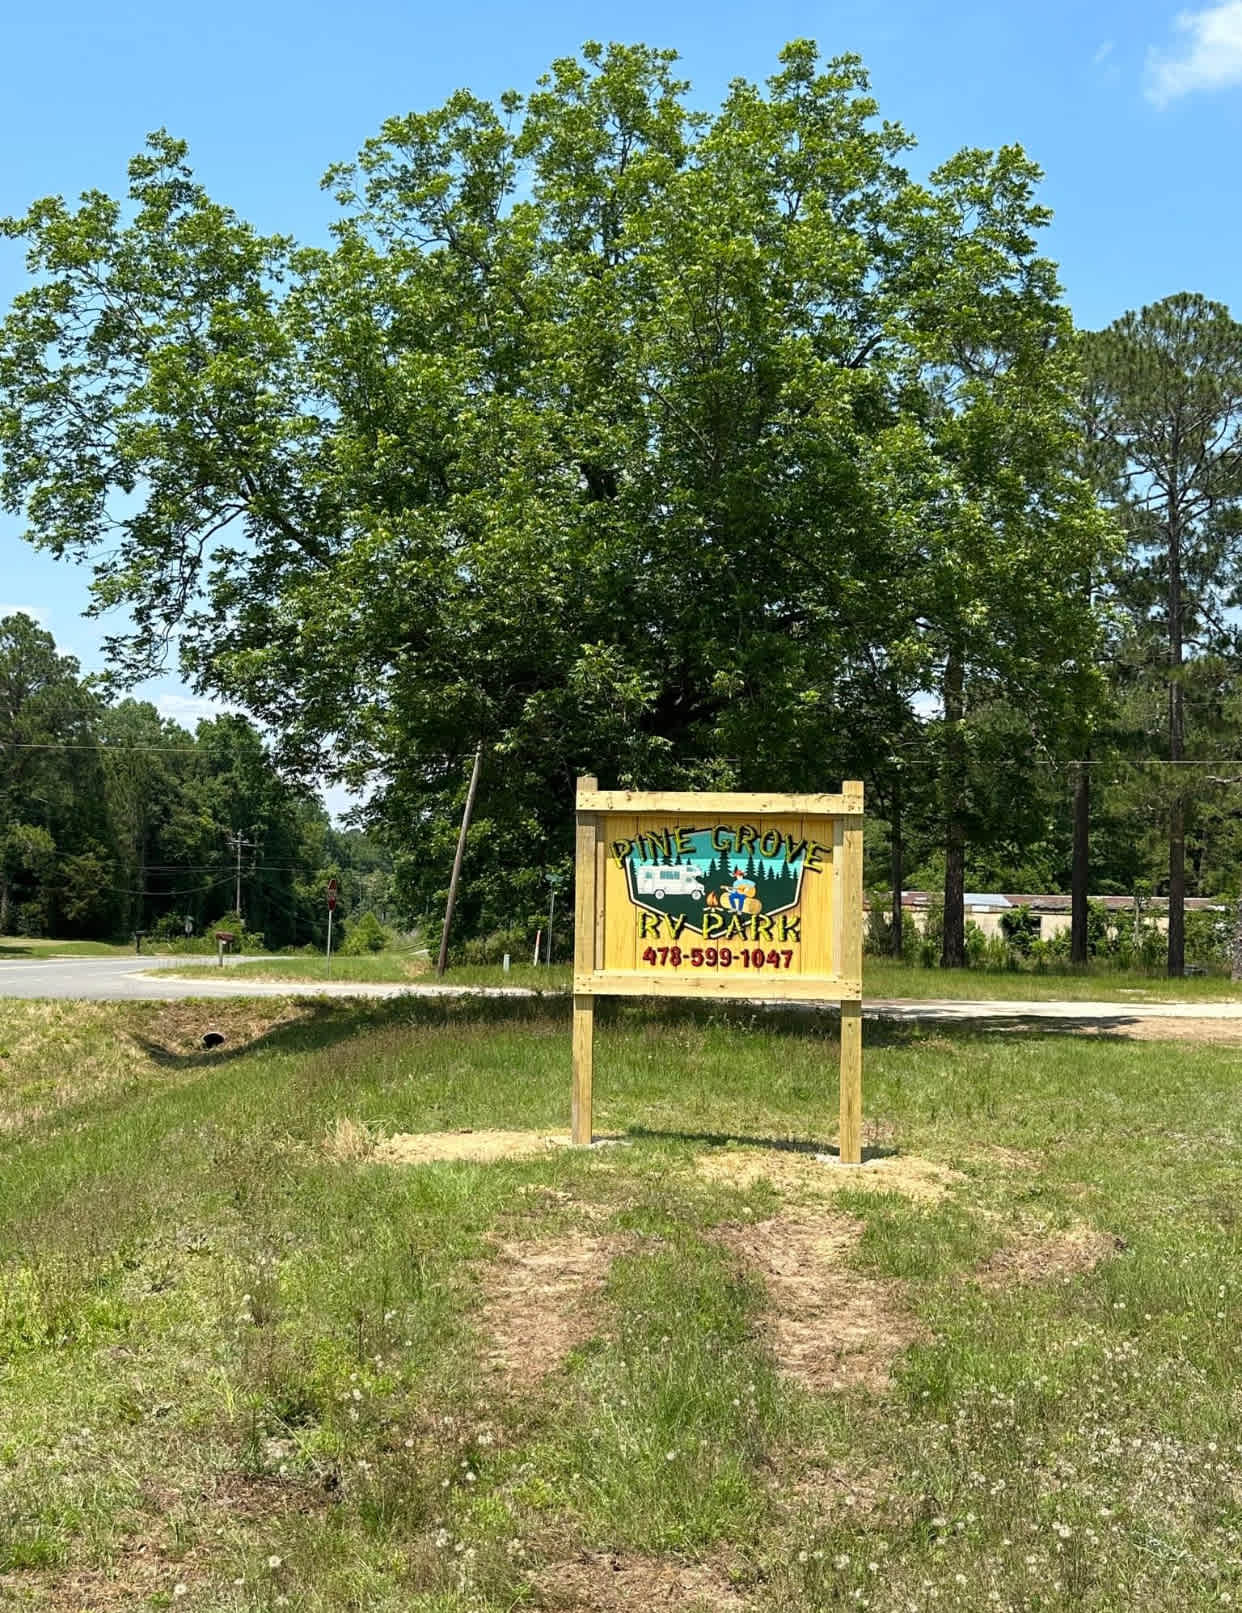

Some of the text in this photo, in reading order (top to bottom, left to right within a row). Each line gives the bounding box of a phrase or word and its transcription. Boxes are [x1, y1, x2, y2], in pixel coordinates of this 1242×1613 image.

[609, 824, 832, 873] PINE GROVE
[637, 911, 801, 942] RV PARK
[642, 945, 793, 969] 478-599-1047
